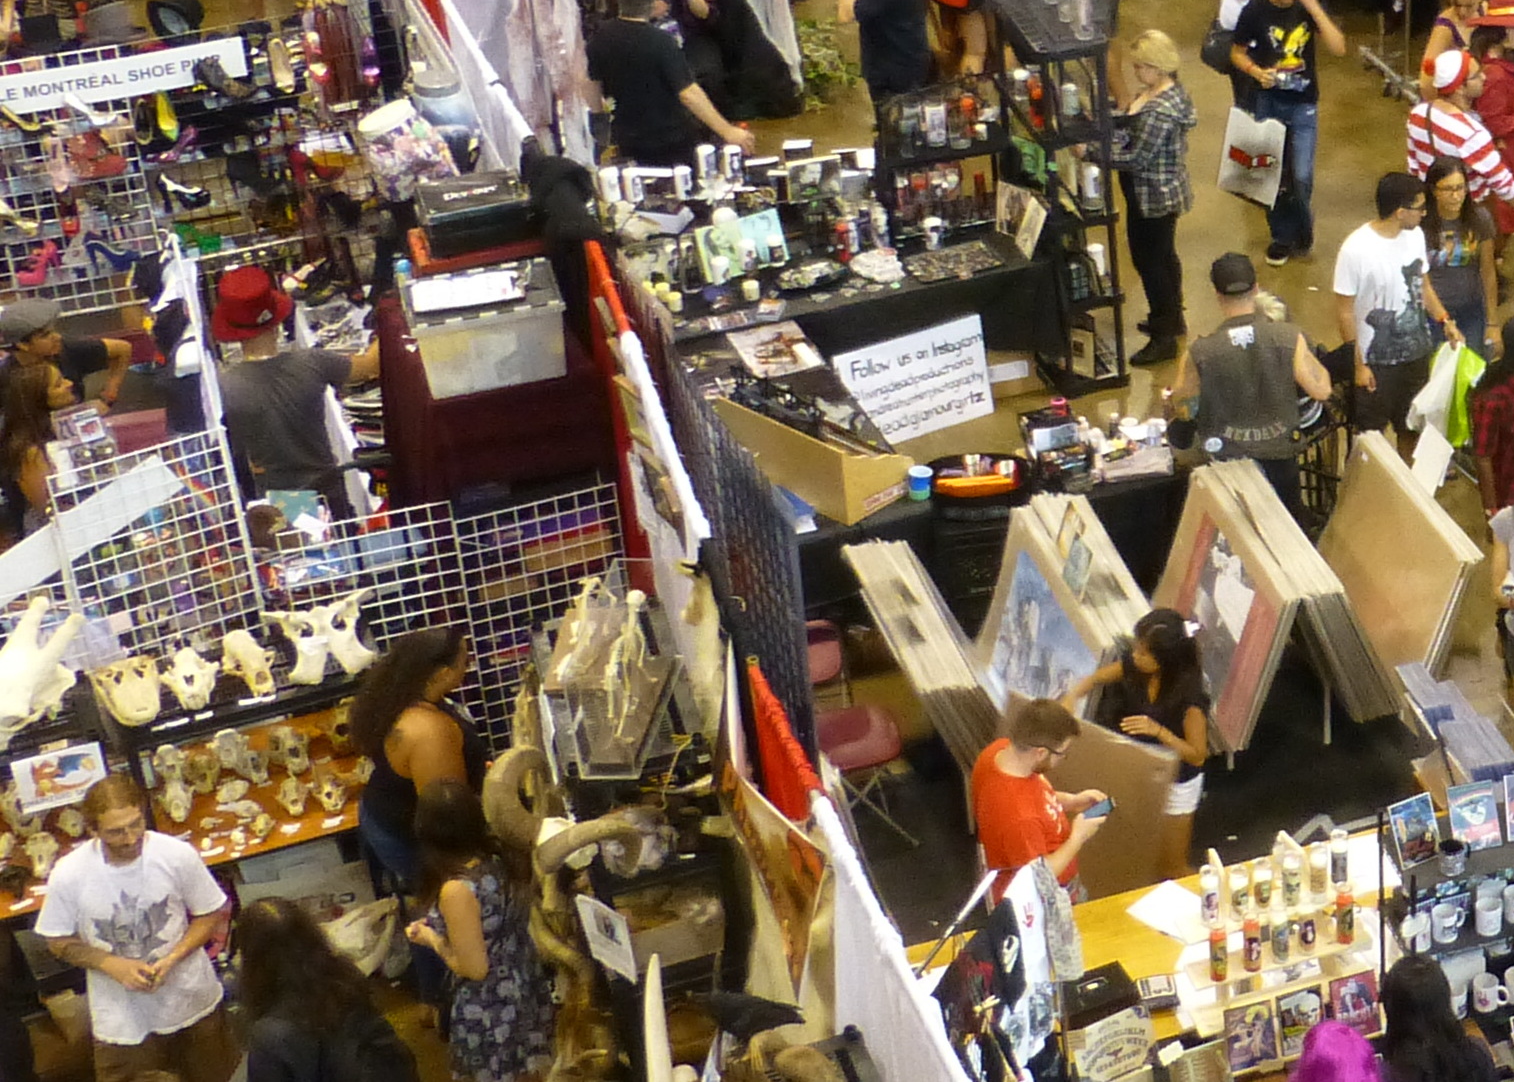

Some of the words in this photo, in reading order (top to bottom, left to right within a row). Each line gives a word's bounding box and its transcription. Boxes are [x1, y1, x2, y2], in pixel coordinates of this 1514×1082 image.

[127, 61, 176, 83] SHOE
[181, 53, 221, 73] PIP
[850, 358, 891, 382] Follow
[897, 351, 912, 368] us
[916, 347, 930, 360] on
[931, 333, 983, 358] Instagram
